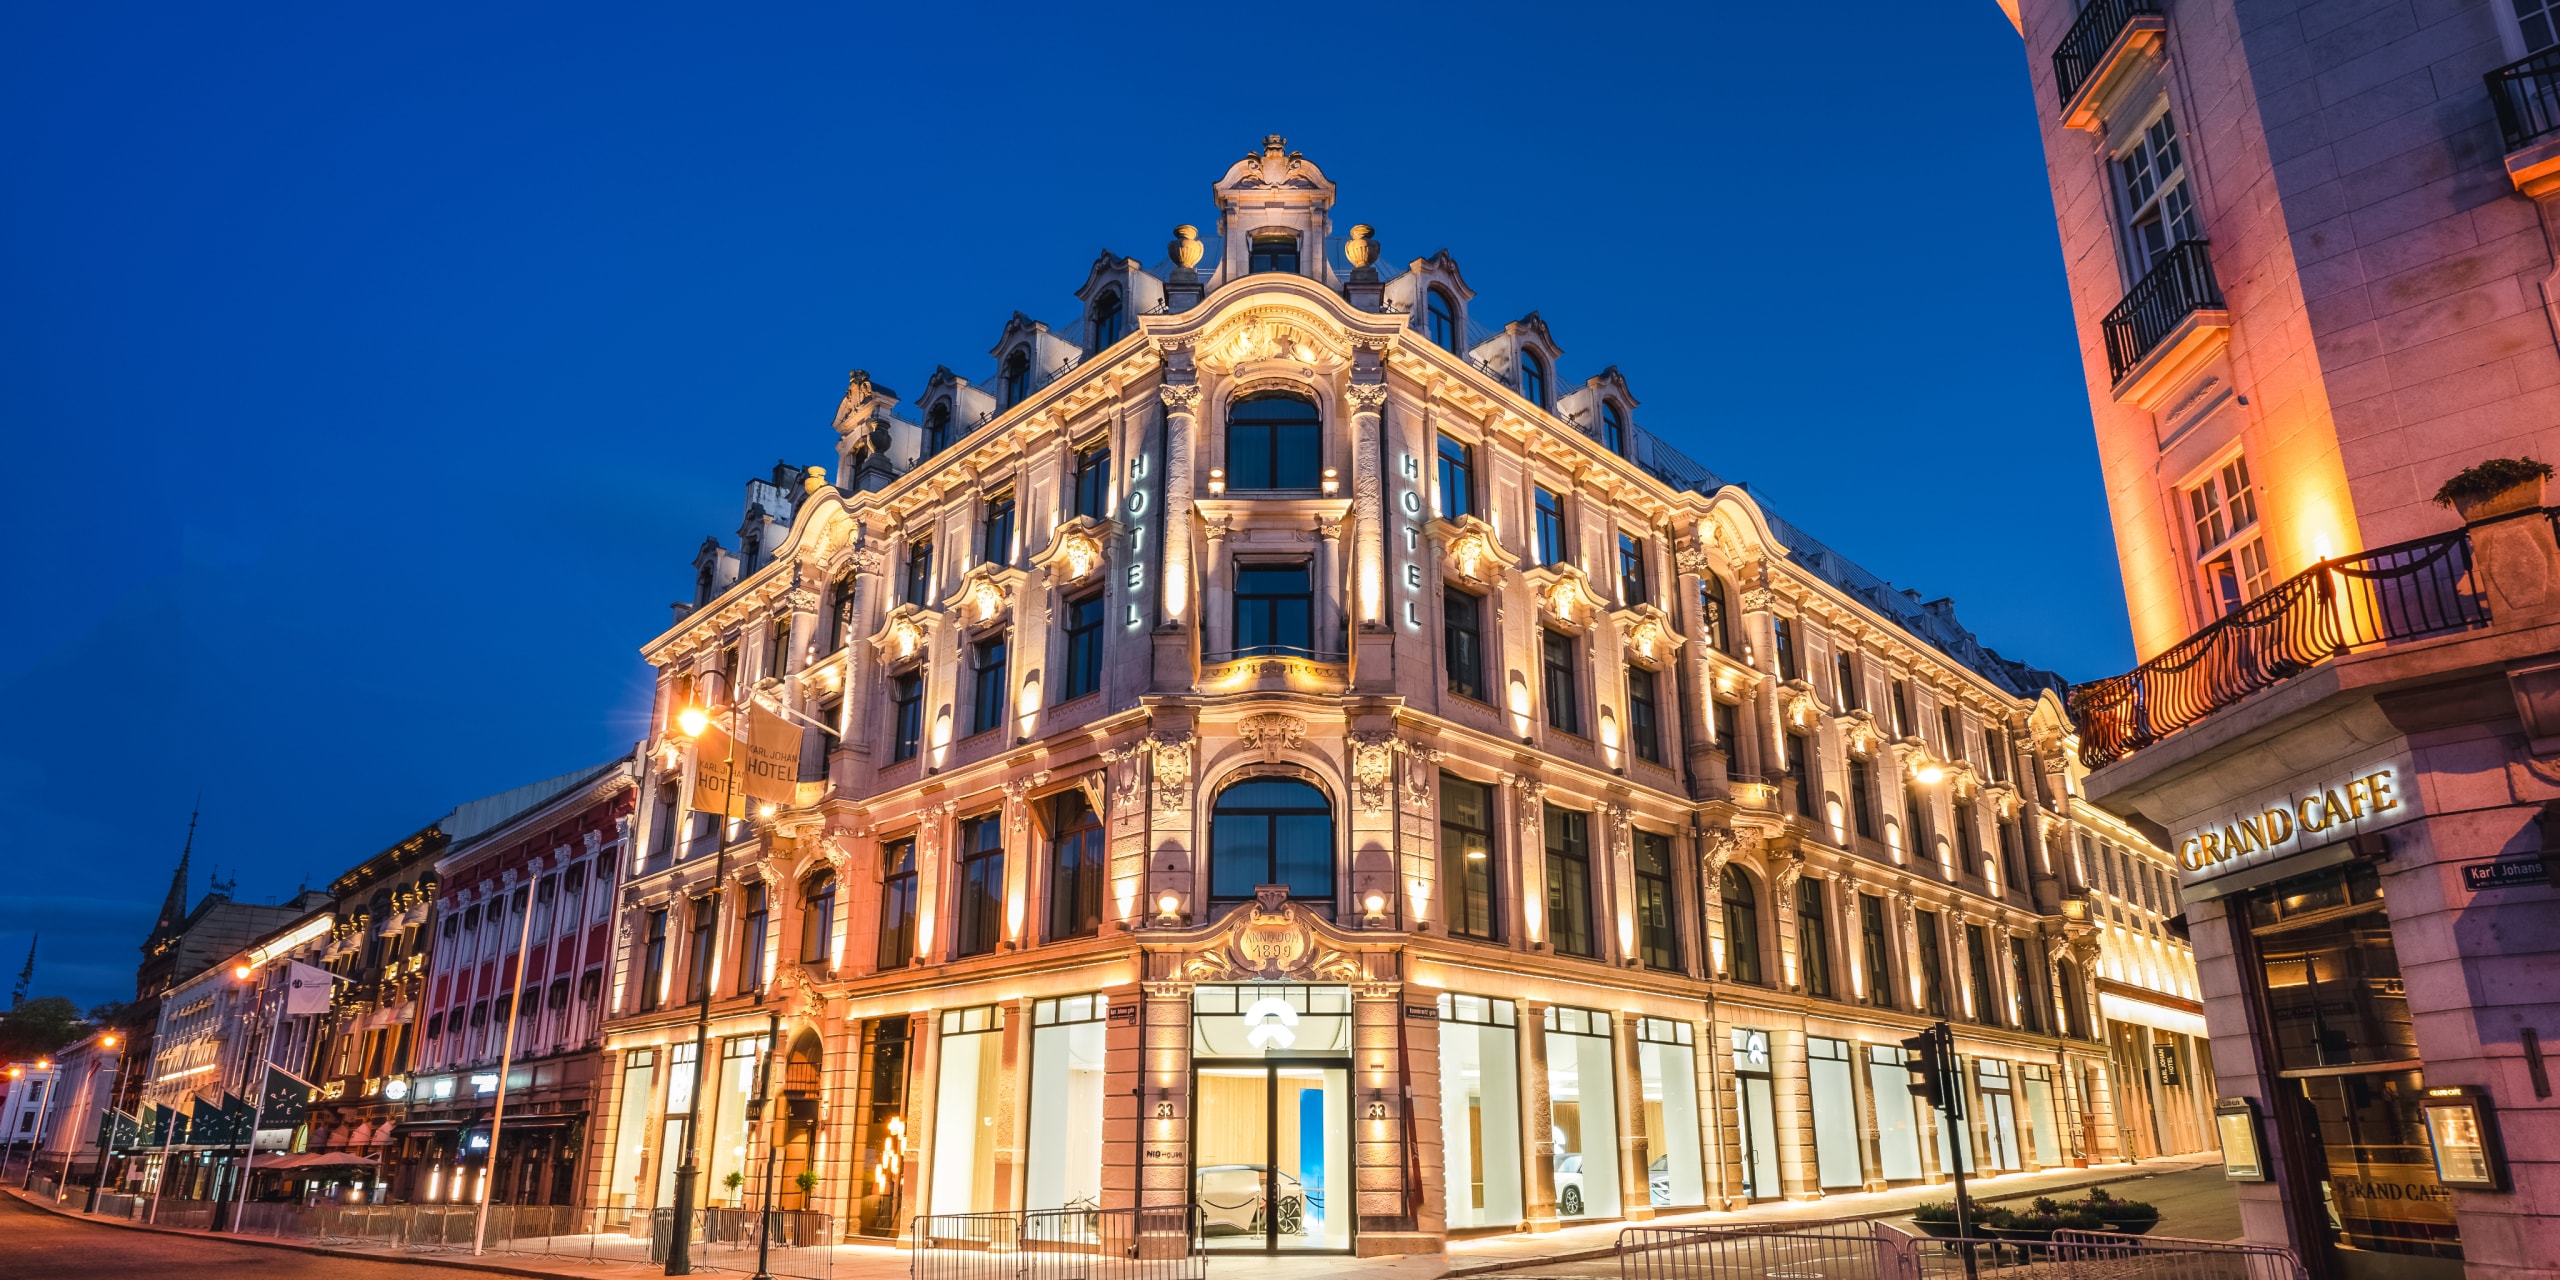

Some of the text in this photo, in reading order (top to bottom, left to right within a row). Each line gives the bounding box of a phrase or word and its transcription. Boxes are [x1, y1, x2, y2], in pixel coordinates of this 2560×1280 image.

[1126, 454, 1145, 626] HOTEL
[1404, 454, 1422, 627] HOTEL
[749, 744, 798, 763] KARL JOHAN
[699, 760, 719, 773] KARL
[748, 757, 795, 782] HOTEL
[698, 772, 745, 797] HOTEL
[2179, 769, 2398, 872] GRAND CAFE
[2470, 863, 2543, 880] Karl Johans
[1252, 944, 1291, 958] 1899
[2167, 1056, 2175, 1075] HOTEL
[1157, 1103, 1174, 1118] 33
[1368, 1103, 1386, 1120] 33
